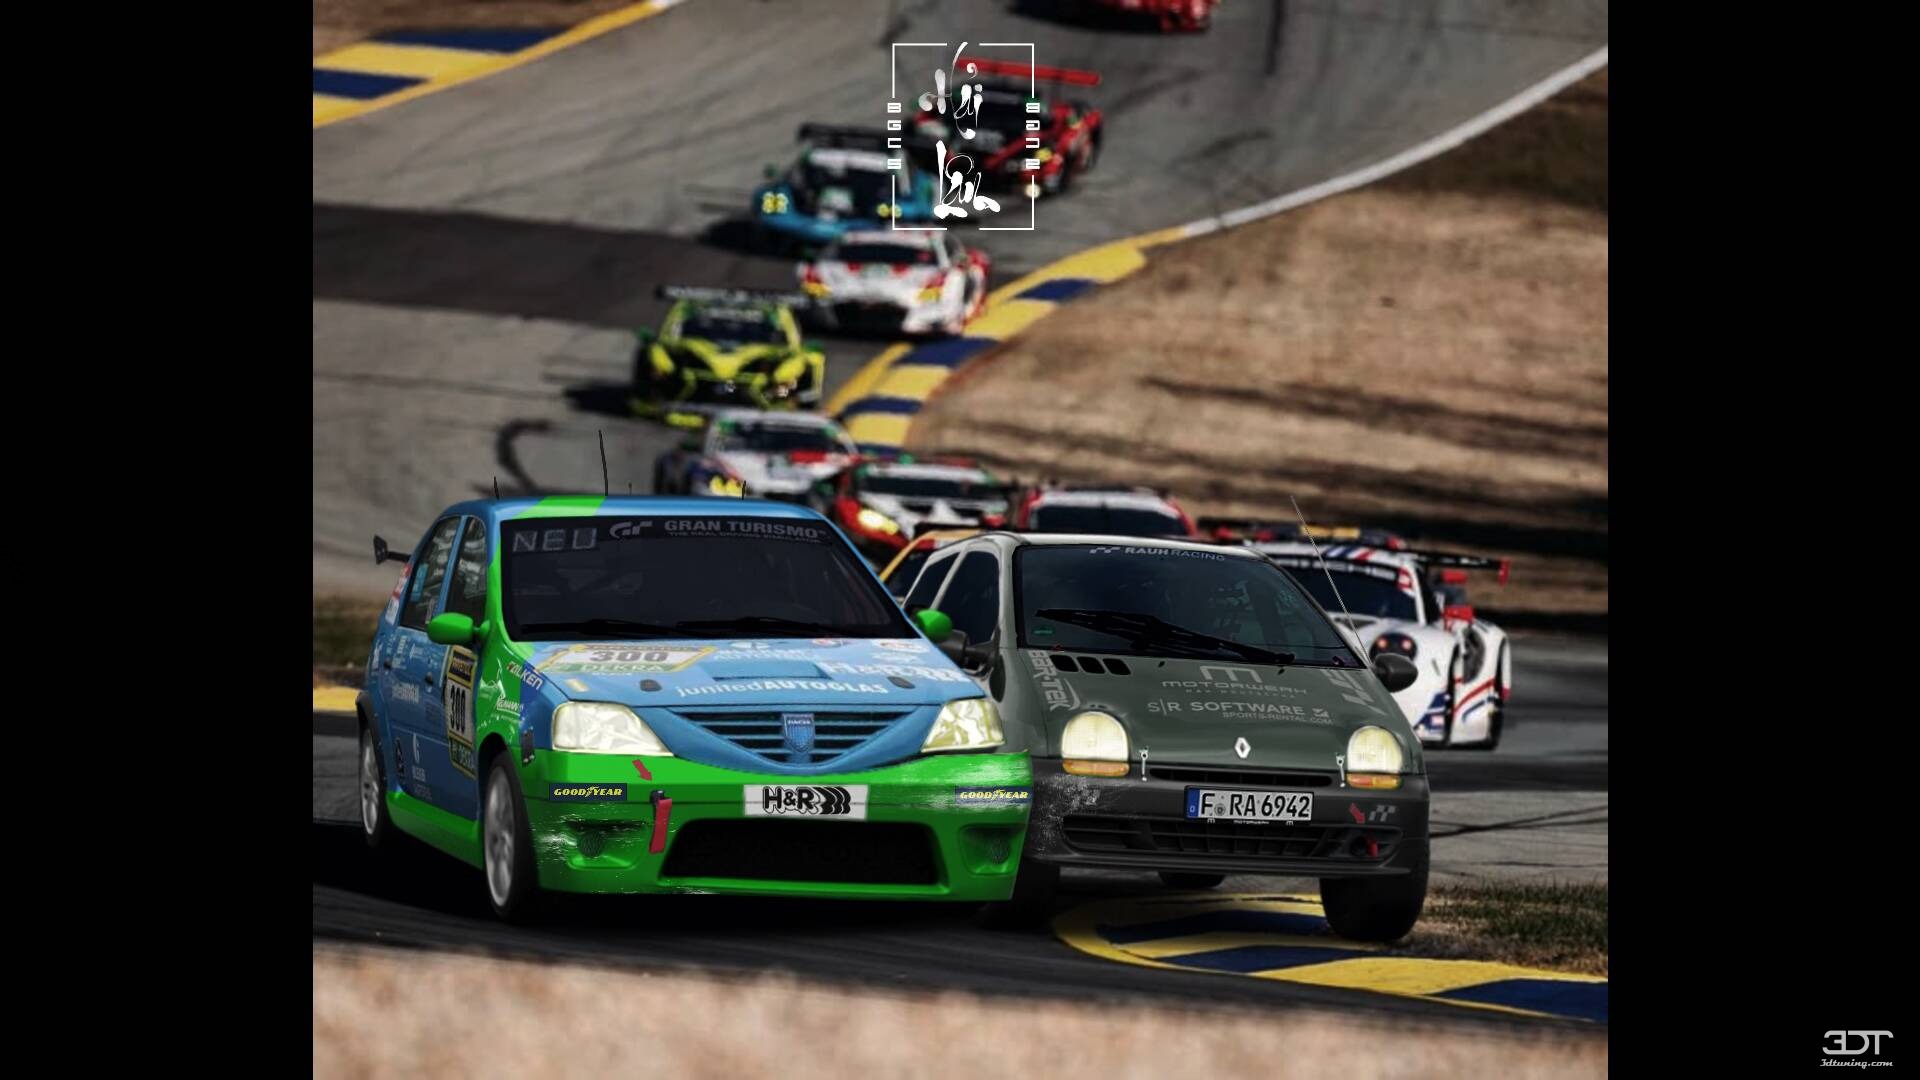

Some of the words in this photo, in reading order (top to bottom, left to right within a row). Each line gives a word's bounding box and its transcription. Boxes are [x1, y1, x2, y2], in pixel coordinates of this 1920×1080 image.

[664, 519, 721, 532] GRAN
[512, 527, 597, 552] NEU
[589, 650, 668, 662] 300
[580, 662, 664, 672] DEKRA
[450, 684, 466, 735] 300
[1189, 700, 1305, 716] SOFTWARE
[553, 786, 623, 798] GOODYEAR
[762, 785, 821, 814] H&R
